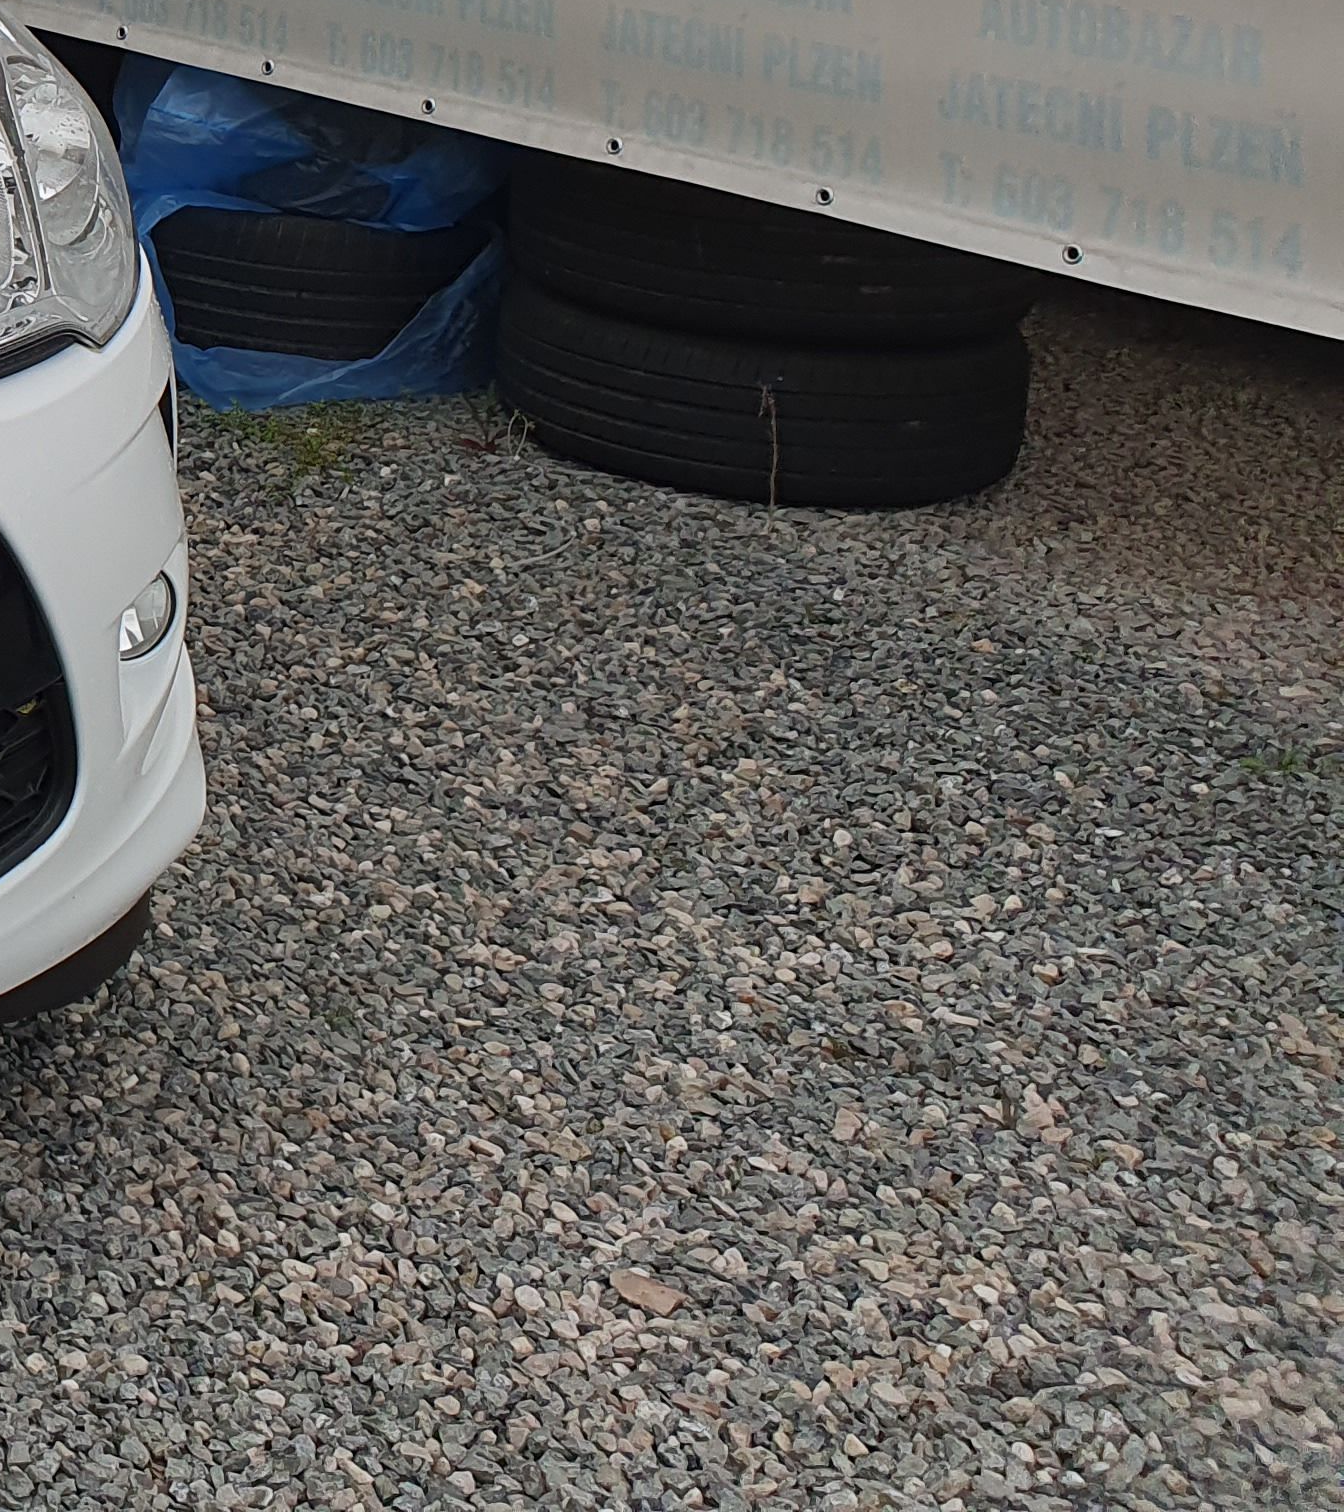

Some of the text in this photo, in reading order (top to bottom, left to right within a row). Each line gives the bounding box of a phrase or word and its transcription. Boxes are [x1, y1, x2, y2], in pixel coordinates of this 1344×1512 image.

[239, 7, 288, 53] 514
[431, 44, 557, 111] 718 514
[641, 91, 885, 185] 603 718 514
[1104, 187, 1186, 255] 718
[1210, 211, 1303, 277] 514
